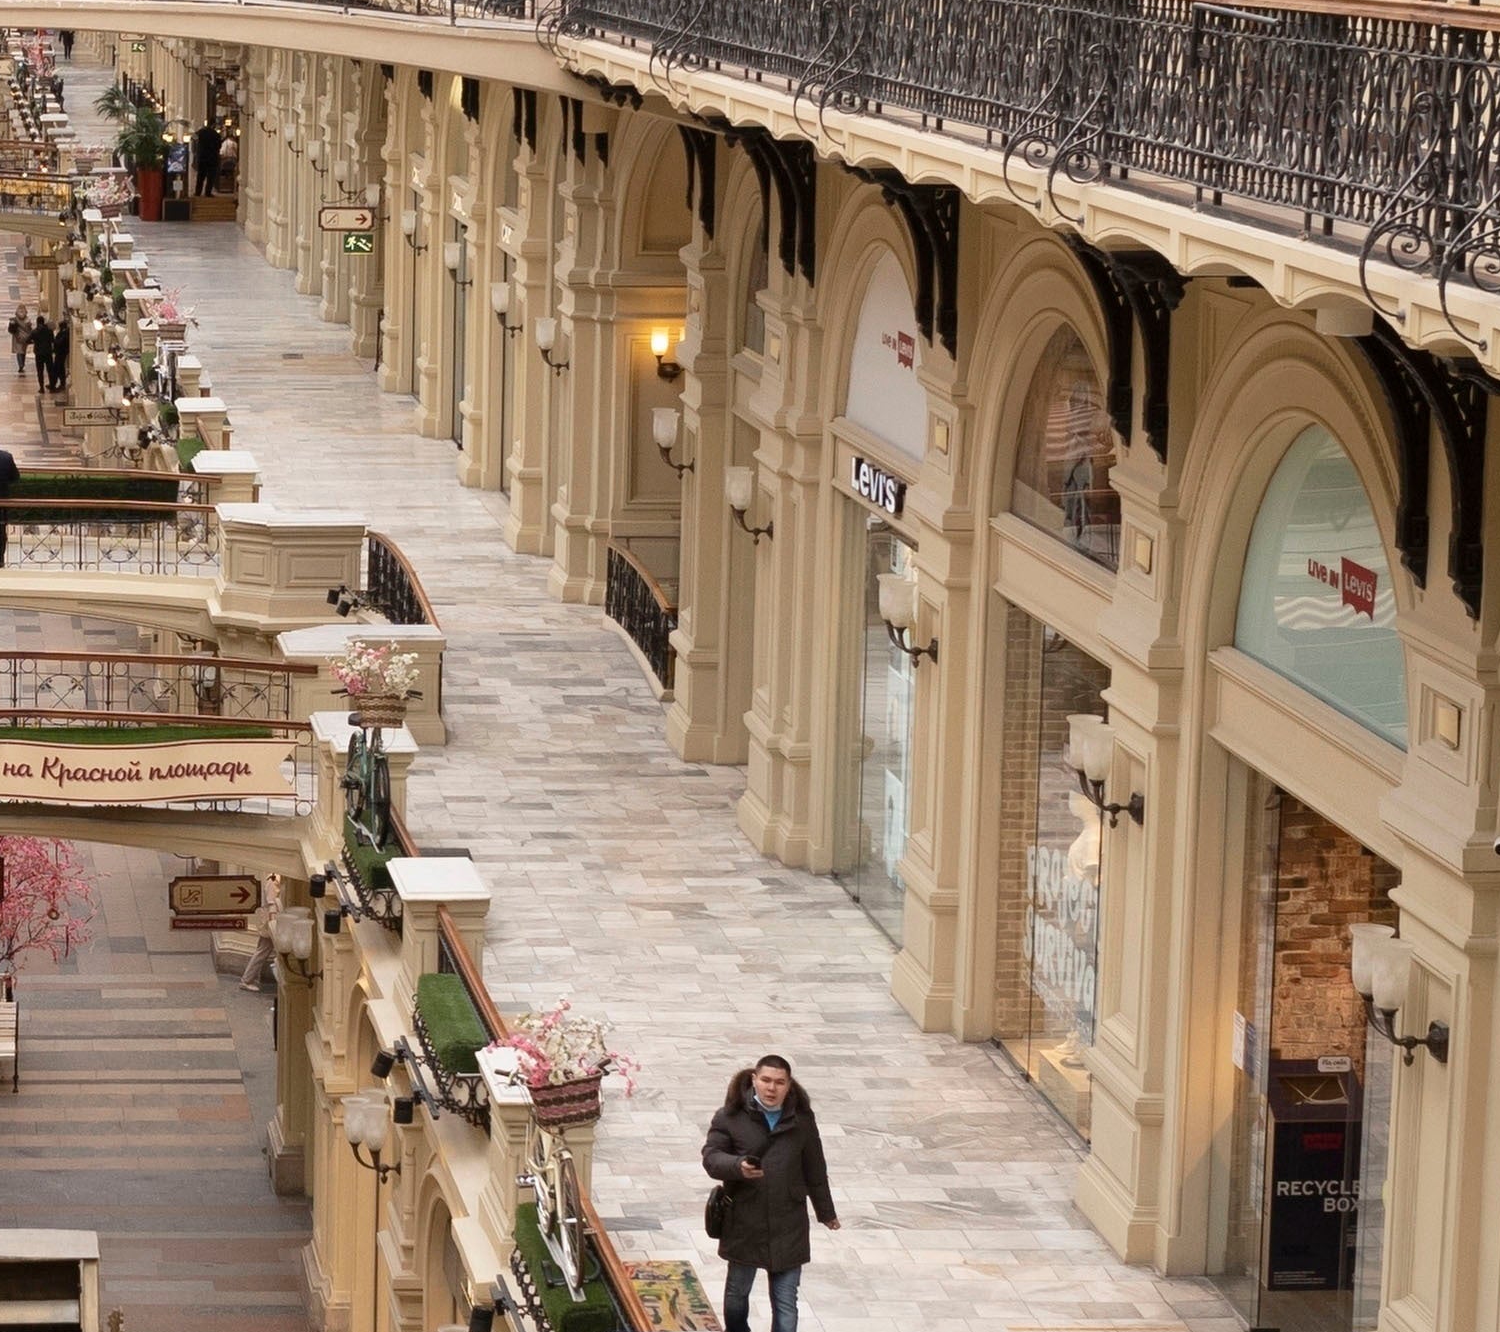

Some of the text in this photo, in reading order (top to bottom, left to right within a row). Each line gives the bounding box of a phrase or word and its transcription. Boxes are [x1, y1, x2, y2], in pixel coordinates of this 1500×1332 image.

[2, 760, 34, 778] на
[41, 755, 143, 787] Красной
[149, 760, 252, 784] площади
[1323, 1197, 1360, 1213] BOX
